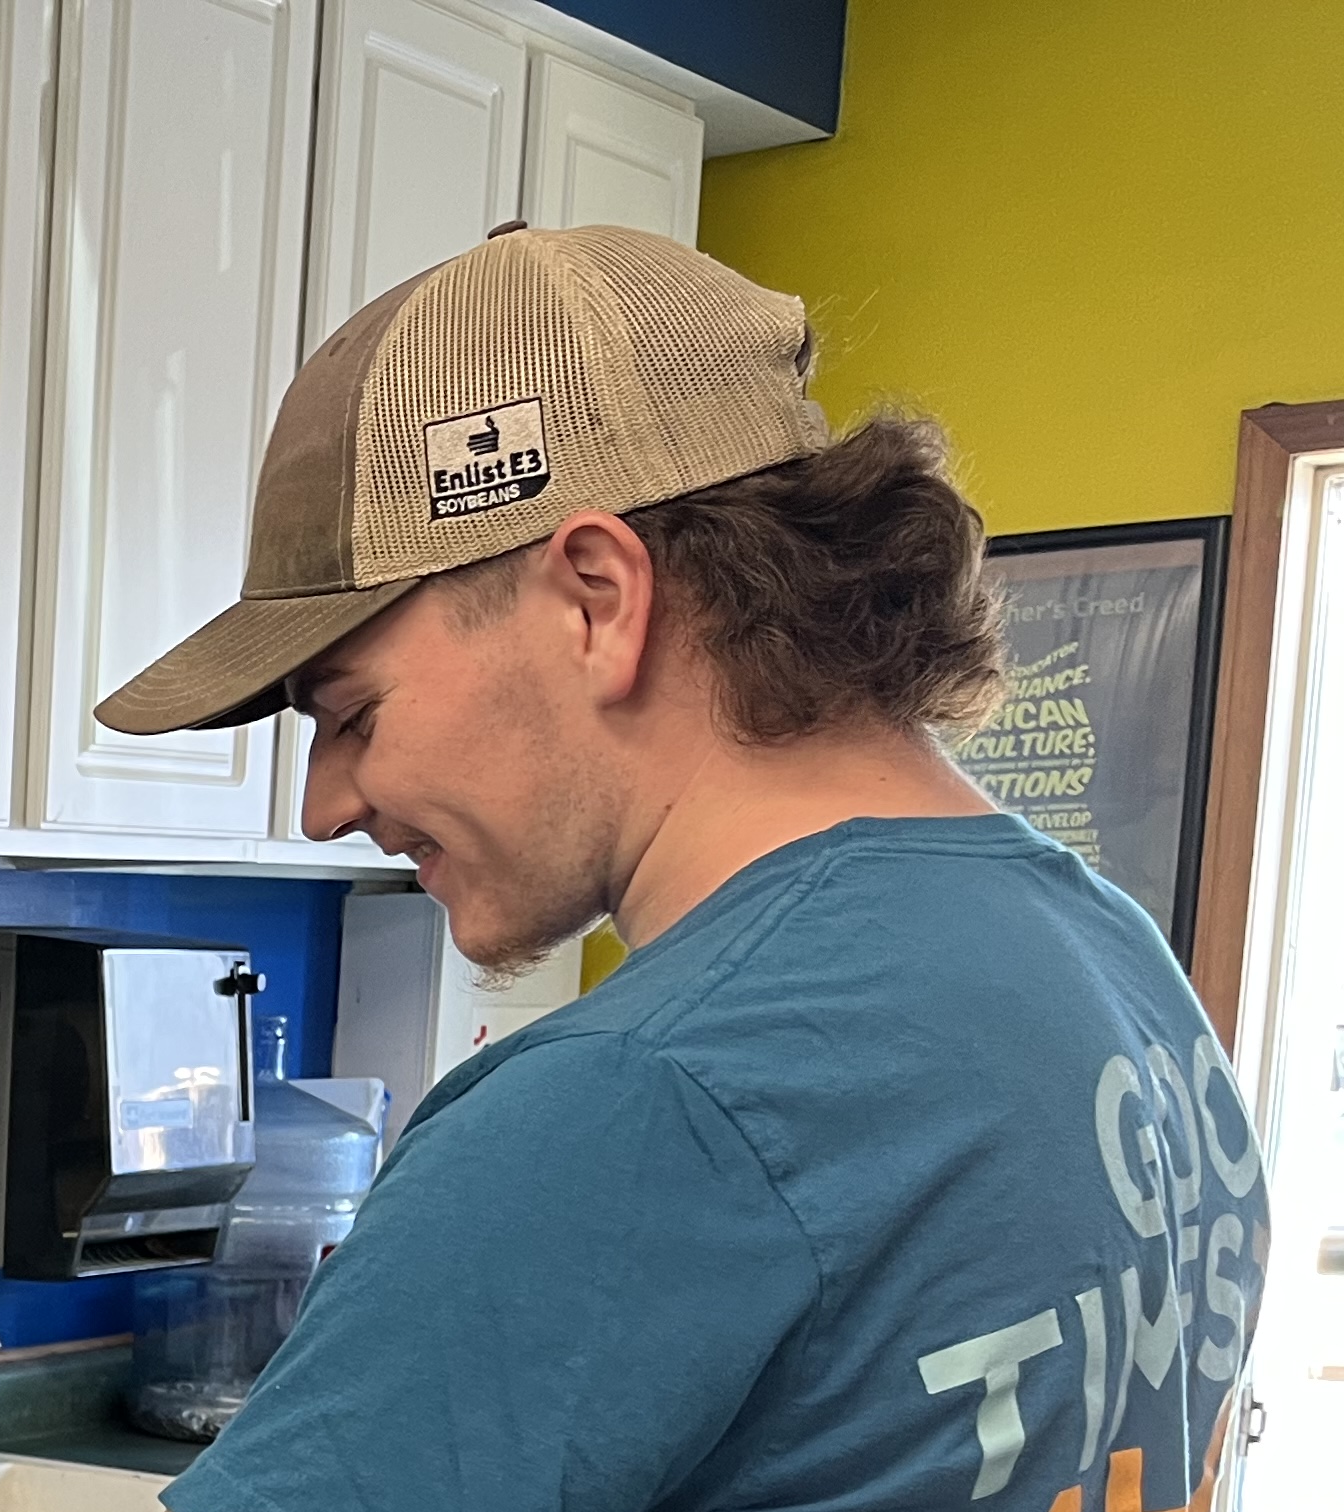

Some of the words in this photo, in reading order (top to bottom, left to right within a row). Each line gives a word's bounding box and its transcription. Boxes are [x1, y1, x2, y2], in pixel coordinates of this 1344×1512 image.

[433, 459, 507, 494] Enlist
[509, 448, 543, 476] E3
[436, 484, 521, 515] SOYBEANS
[1005, 600, 1066, 622] her's
[1074, 591, 1145, 618] Creed
[1012, 664, 1091, 700] HANCE.
[989, 698, 1090, 731] RICAN
[960, 727, 1096, 761] ICULTURE;
[979, 767, 1093, 800] CTIONS
